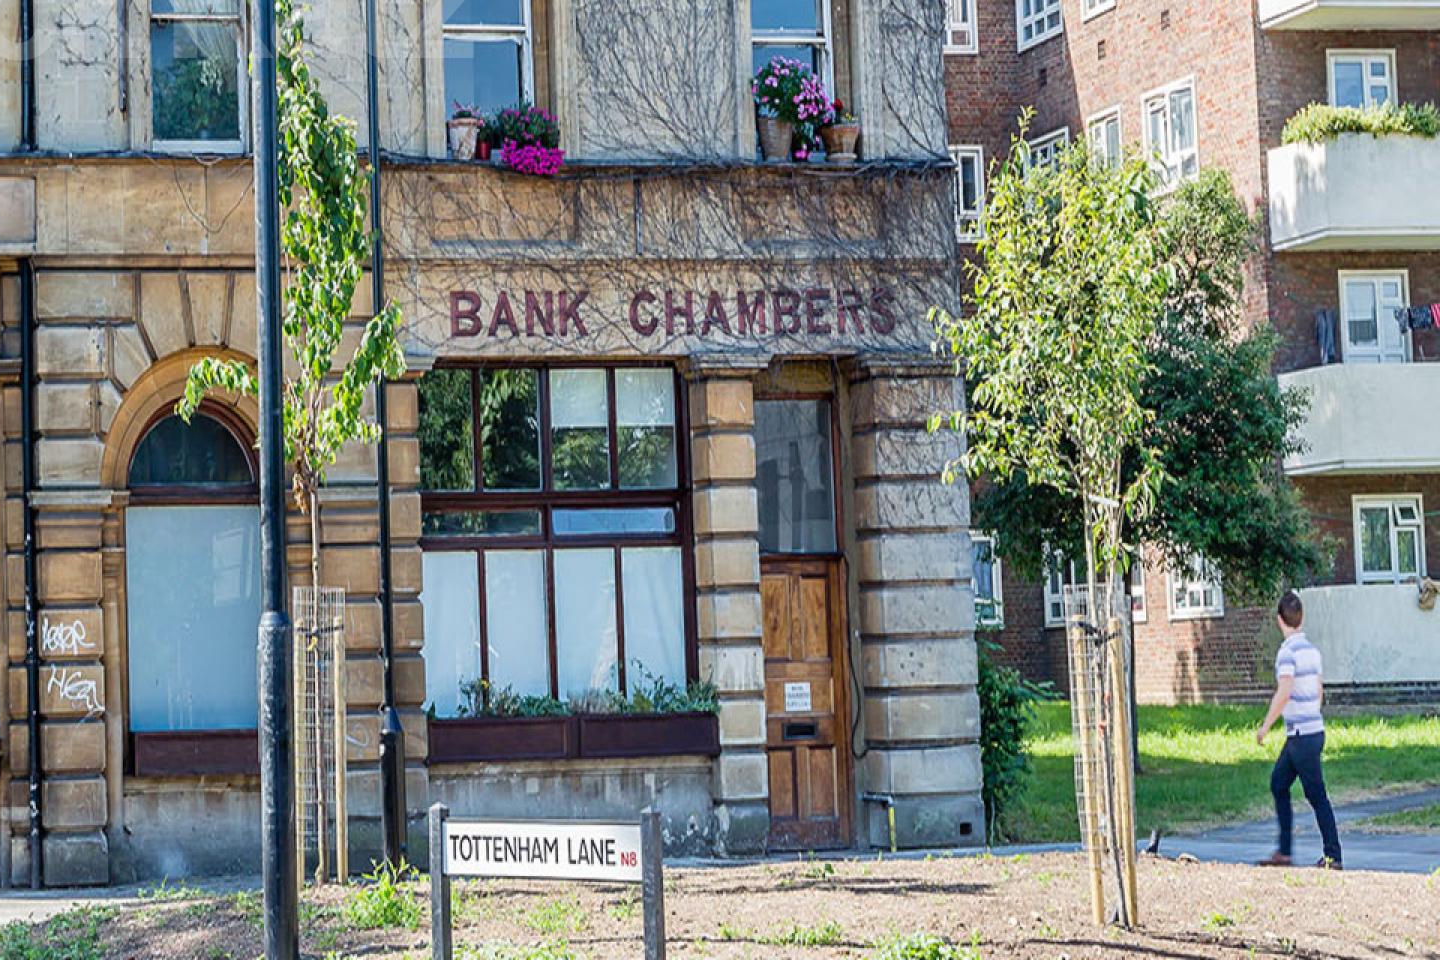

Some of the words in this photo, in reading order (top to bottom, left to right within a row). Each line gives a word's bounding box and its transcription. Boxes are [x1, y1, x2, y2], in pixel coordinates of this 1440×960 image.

[449, 290, 589, 337] BANK
[629, 289, 897, 337] CHAMBERS
[449, 834, 559, 865] TOTTENHAM
[567, 838, 617, 866] LANE
[620, 851, 637, 868] N8
